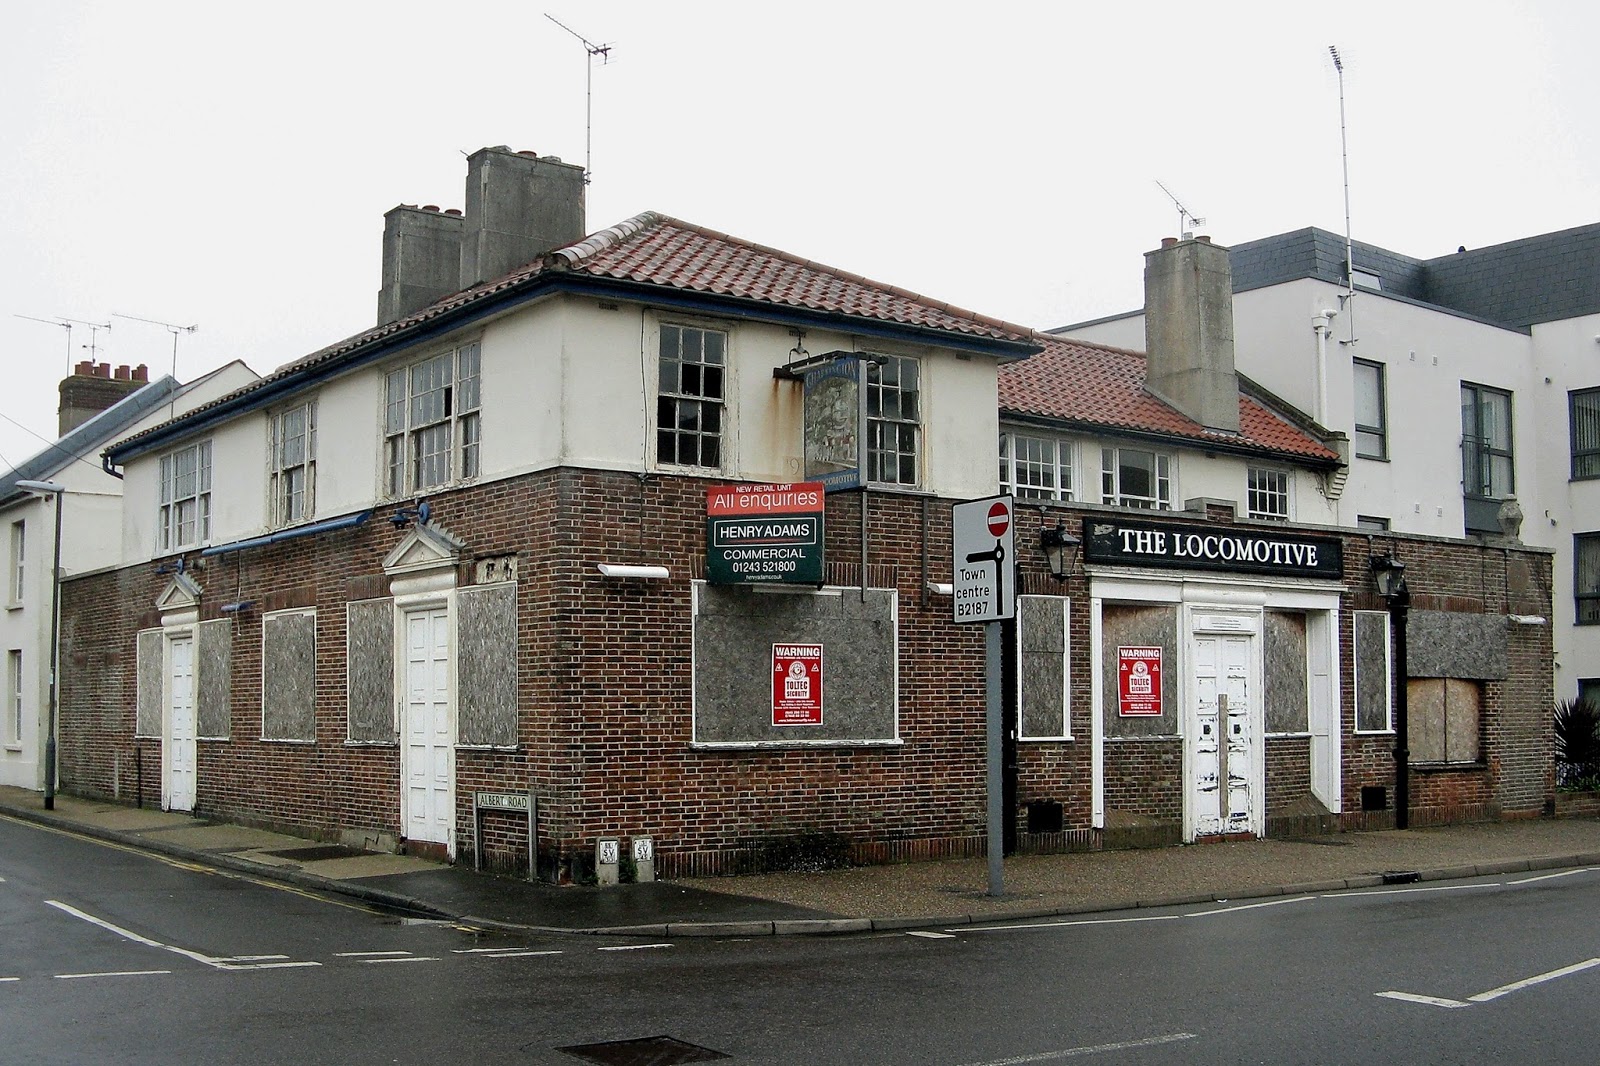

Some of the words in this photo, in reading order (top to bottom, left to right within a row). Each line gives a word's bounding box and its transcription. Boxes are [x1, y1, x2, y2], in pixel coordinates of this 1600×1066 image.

[713, 494, 734, 508] All
[740, 492, 818, 510] enquiries
[720, 525, 763, 538] HENRY
[764, 524, 810, 537] ADAMS
[1118, 529, 1167, 555] THE
[1172, 533, 1318, 566] LOCOMOTIVE
[723, 548, 806, 560] COMMERCIAL
[732, 562, 760, 572] 01243
[762, 561, 796, 572] 521800
[960, 569, 986, 581] Town
[956, 585, 990, 599] centre
[958, 602, 988, 616] B2187
[775, 647, 820, 656] WARNING
[1120, 649, 1160, 657] WARNING
[786, 681, 807, 690] TOLTEC
[479, 795, 504, 806] ALBERT
[508, 797, 527, 808] ROAD
[638, 846, 648, 854] SV
